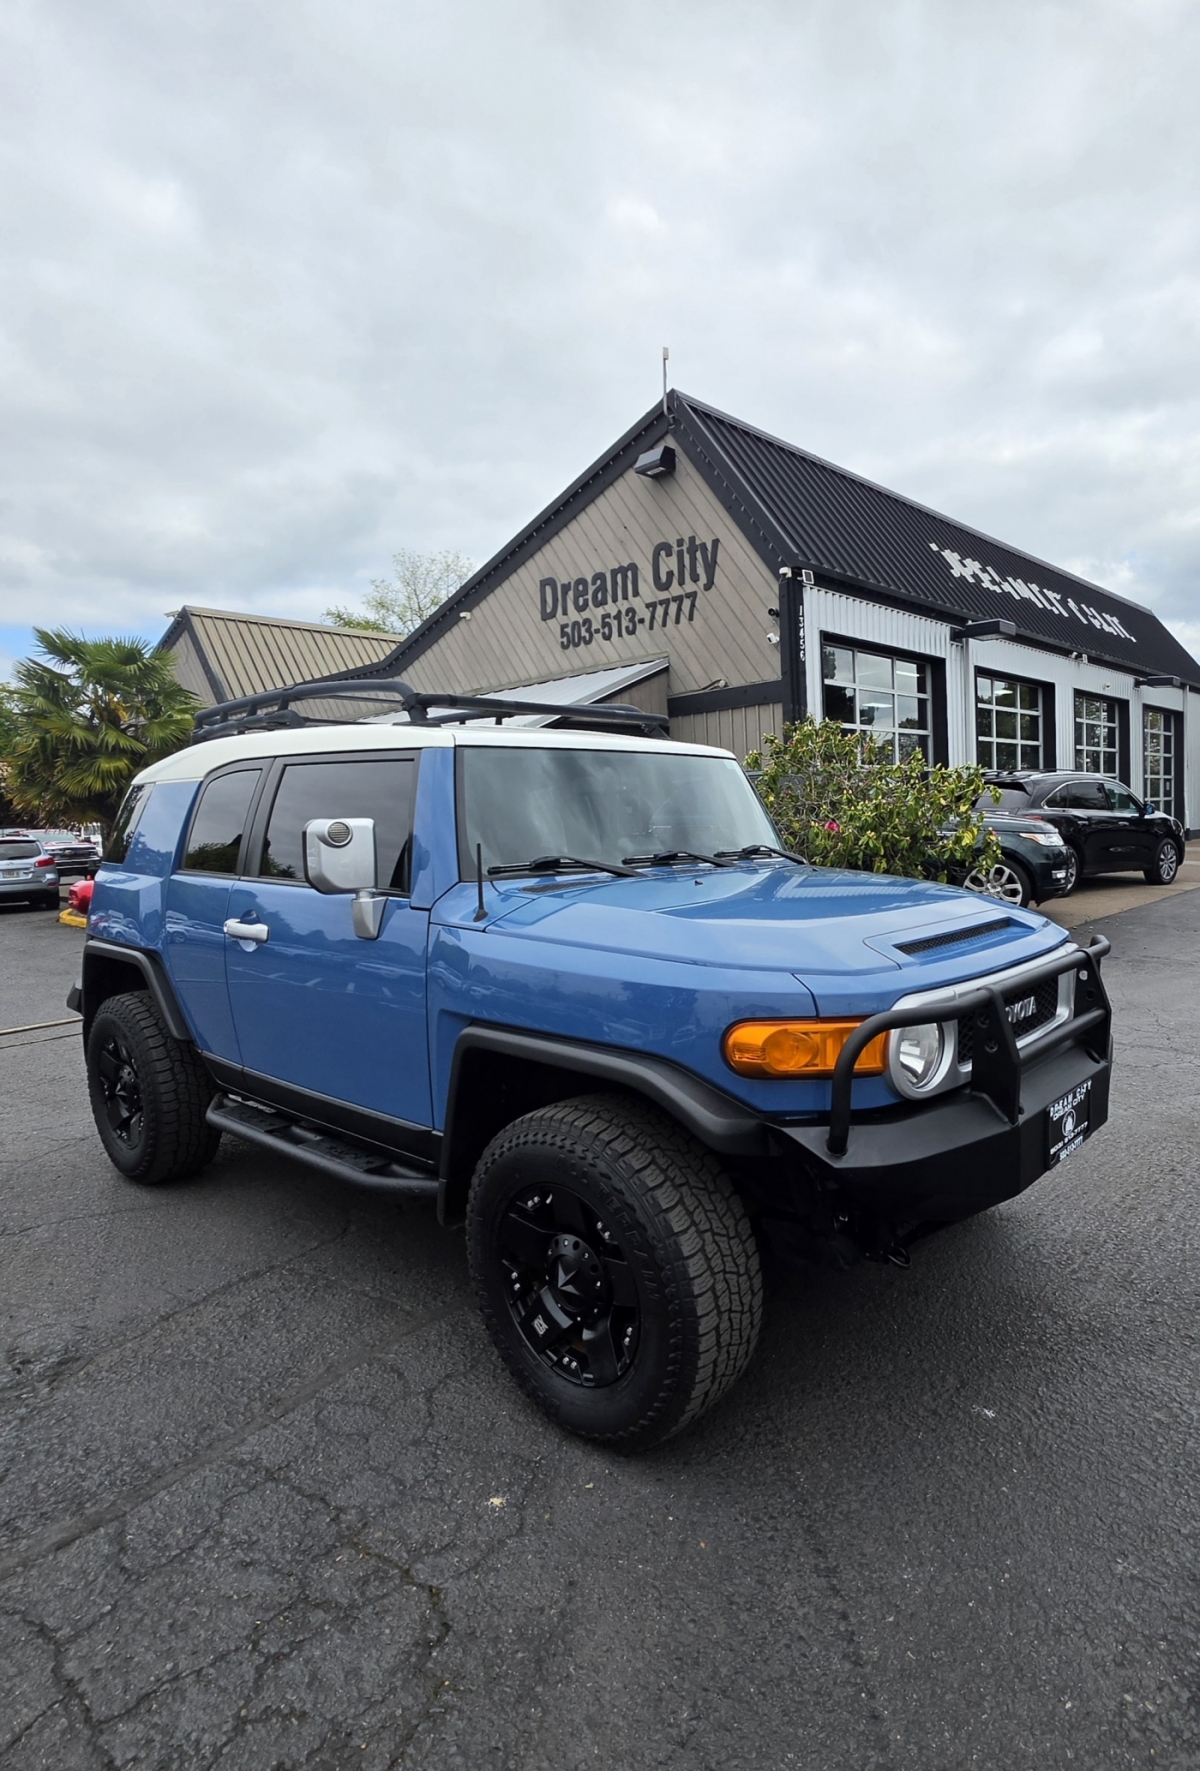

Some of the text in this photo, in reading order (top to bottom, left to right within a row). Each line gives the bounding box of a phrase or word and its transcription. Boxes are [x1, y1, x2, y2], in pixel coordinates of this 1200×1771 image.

[539, 535, 720, 621] Dream City
[560, 591, 698, 651] 503-513-7777
[1004, 995, 1038, 1024] YOTA
[1050, 1080, 1092, 1118] DREAM CITY
